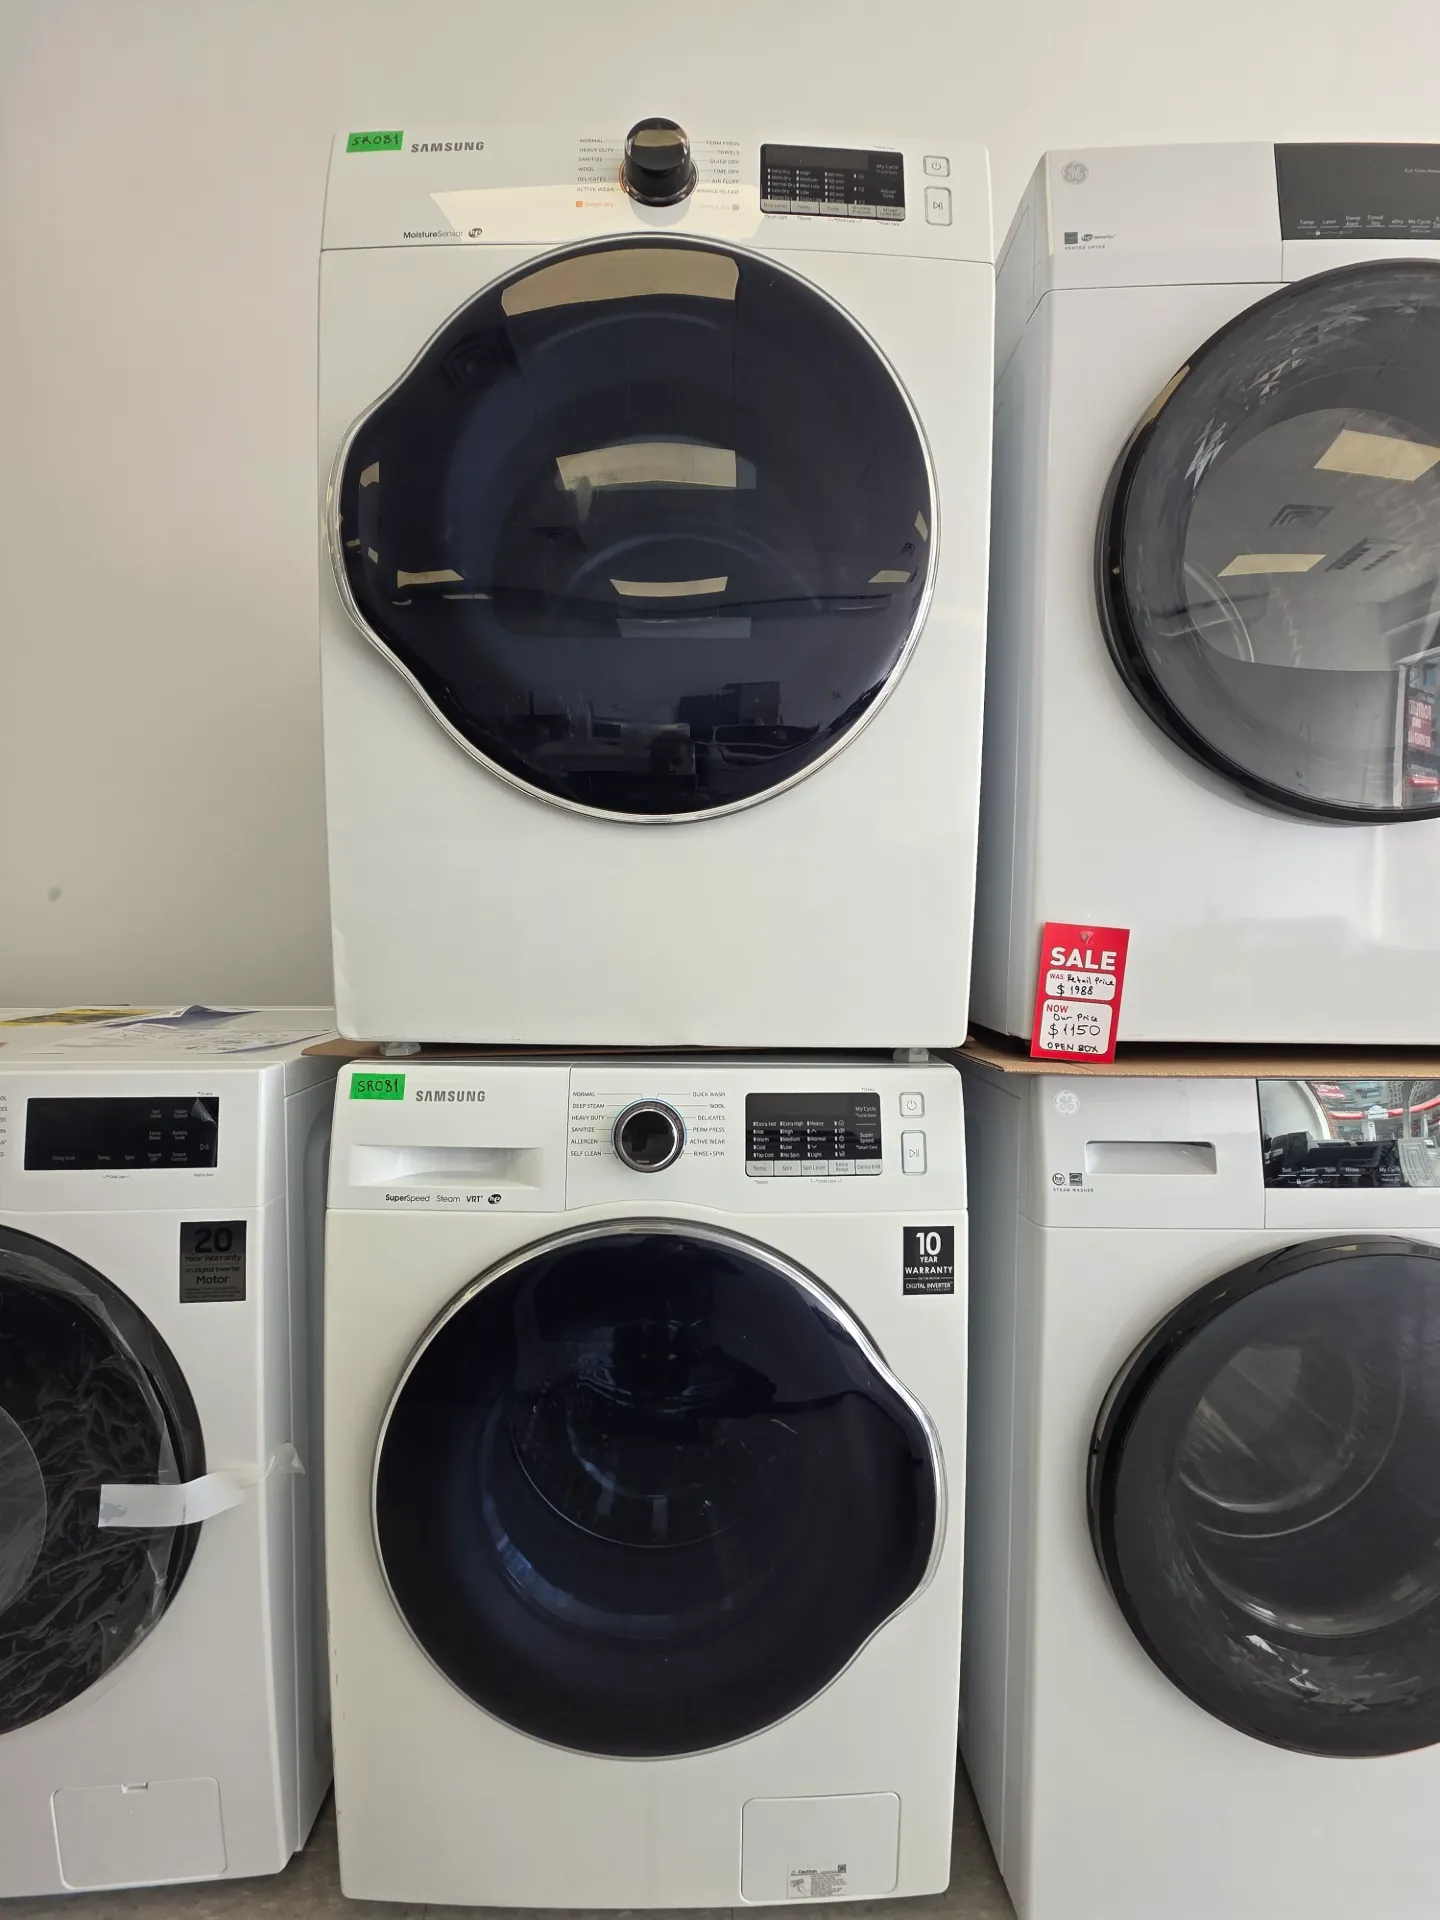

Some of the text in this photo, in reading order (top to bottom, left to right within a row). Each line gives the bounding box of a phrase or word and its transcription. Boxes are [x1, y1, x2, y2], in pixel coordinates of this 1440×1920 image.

[411, 141, 485, 153] SAMSUNG
[403, 230, 463, 239] MoistureSensor
[1050, 947, 1118, 971] SALE
[1095, 977, 1114, 986] Price
[1046, 1004, 1068, 1013] NOW
[1077, 1014, 1098, 1022] Price
[1047, 1042, 1099, 1053] OPEN BOX
[357, 1078, 399, 1093] SR081
[416, 1090, 486, 1102] SAMSUNG
[385, 1193, 430, 1203] SuperSpeed
[194, 1227, 233, 1253] 20
[916, 1232, 941, 1256] 10
[204, 1254, 241, 1262] Warranty
[194, 1266, 215, 1274] Digital
[905, 1266, 953, 1274] WARRANTY
[196, 1276, 230, 1284] Motor
